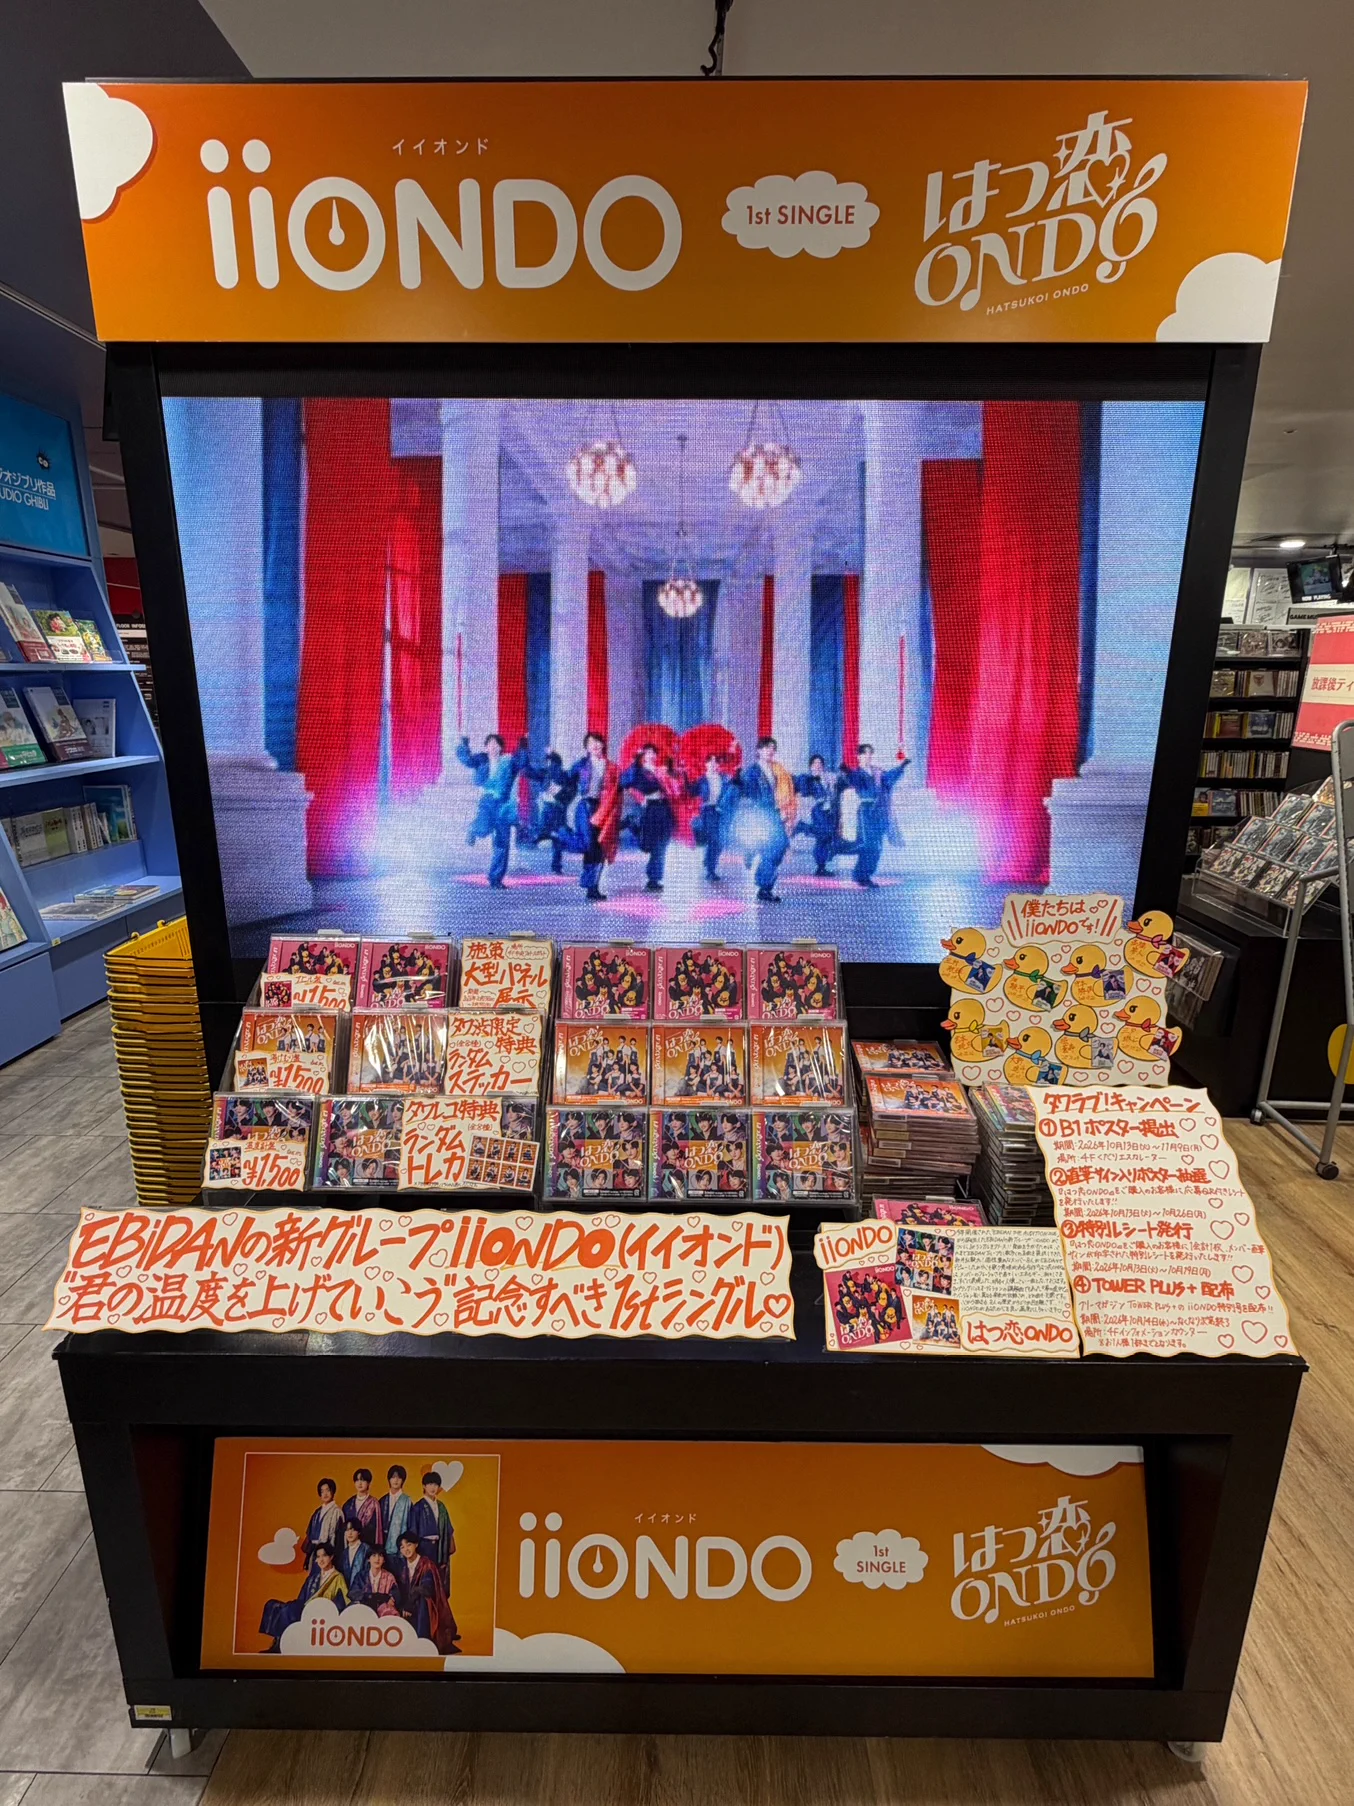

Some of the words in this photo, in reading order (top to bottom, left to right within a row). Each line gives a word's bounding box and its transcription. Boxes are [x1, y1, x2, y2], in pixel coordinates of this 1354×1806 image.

[391, 138, 490, 156] イイオンド
[200, 139, 682, 291] iiONDO
[746, 205, 771, 225] 1st
[778, 205, 855, 225] SINGLE
[986, 292, 1049, 315] HATSUKOI
[1053, 283, 1090, 301] ONDO
[1021, 899, 1085, 917] 僕たちは
[467, 941, 504, 960] 施策
[464, 961, 548, 987] 大型パネル
[493, 987, 536, 1008] 展示
[451, 1016, 521, 1037] タワ渋限定
[495, 1036, 536, 1055] 特典
[448, 1048, 493, 1070] ランダム
[270, 1063, 325, 1095] ¥1500
[448, 1065, 532, 1095] ステッカー
[406, 1100, 500, 1122] タワレコ特典
[403, 1125, 466, 1154] ランダム
[407, 1152, 466, 1185] トレカ
[1201, 1280, 1235, 1300] 配布
[967, 1320, 1073, 1345] はつ恋ONDO
[634, 1512, 698, 1524] イイオンド
[519, 1512, 812, 1601] iiONDO
[873, 1545, 890, 1557] 1st
[856, 1559, 906, 1573] SINGLE
[1003, 1610, 1048, 1627] HATSUKOI
[1050, 1604, 1076, 1617] ONDO
[310, 1618, 403, 1647] iiONDO
